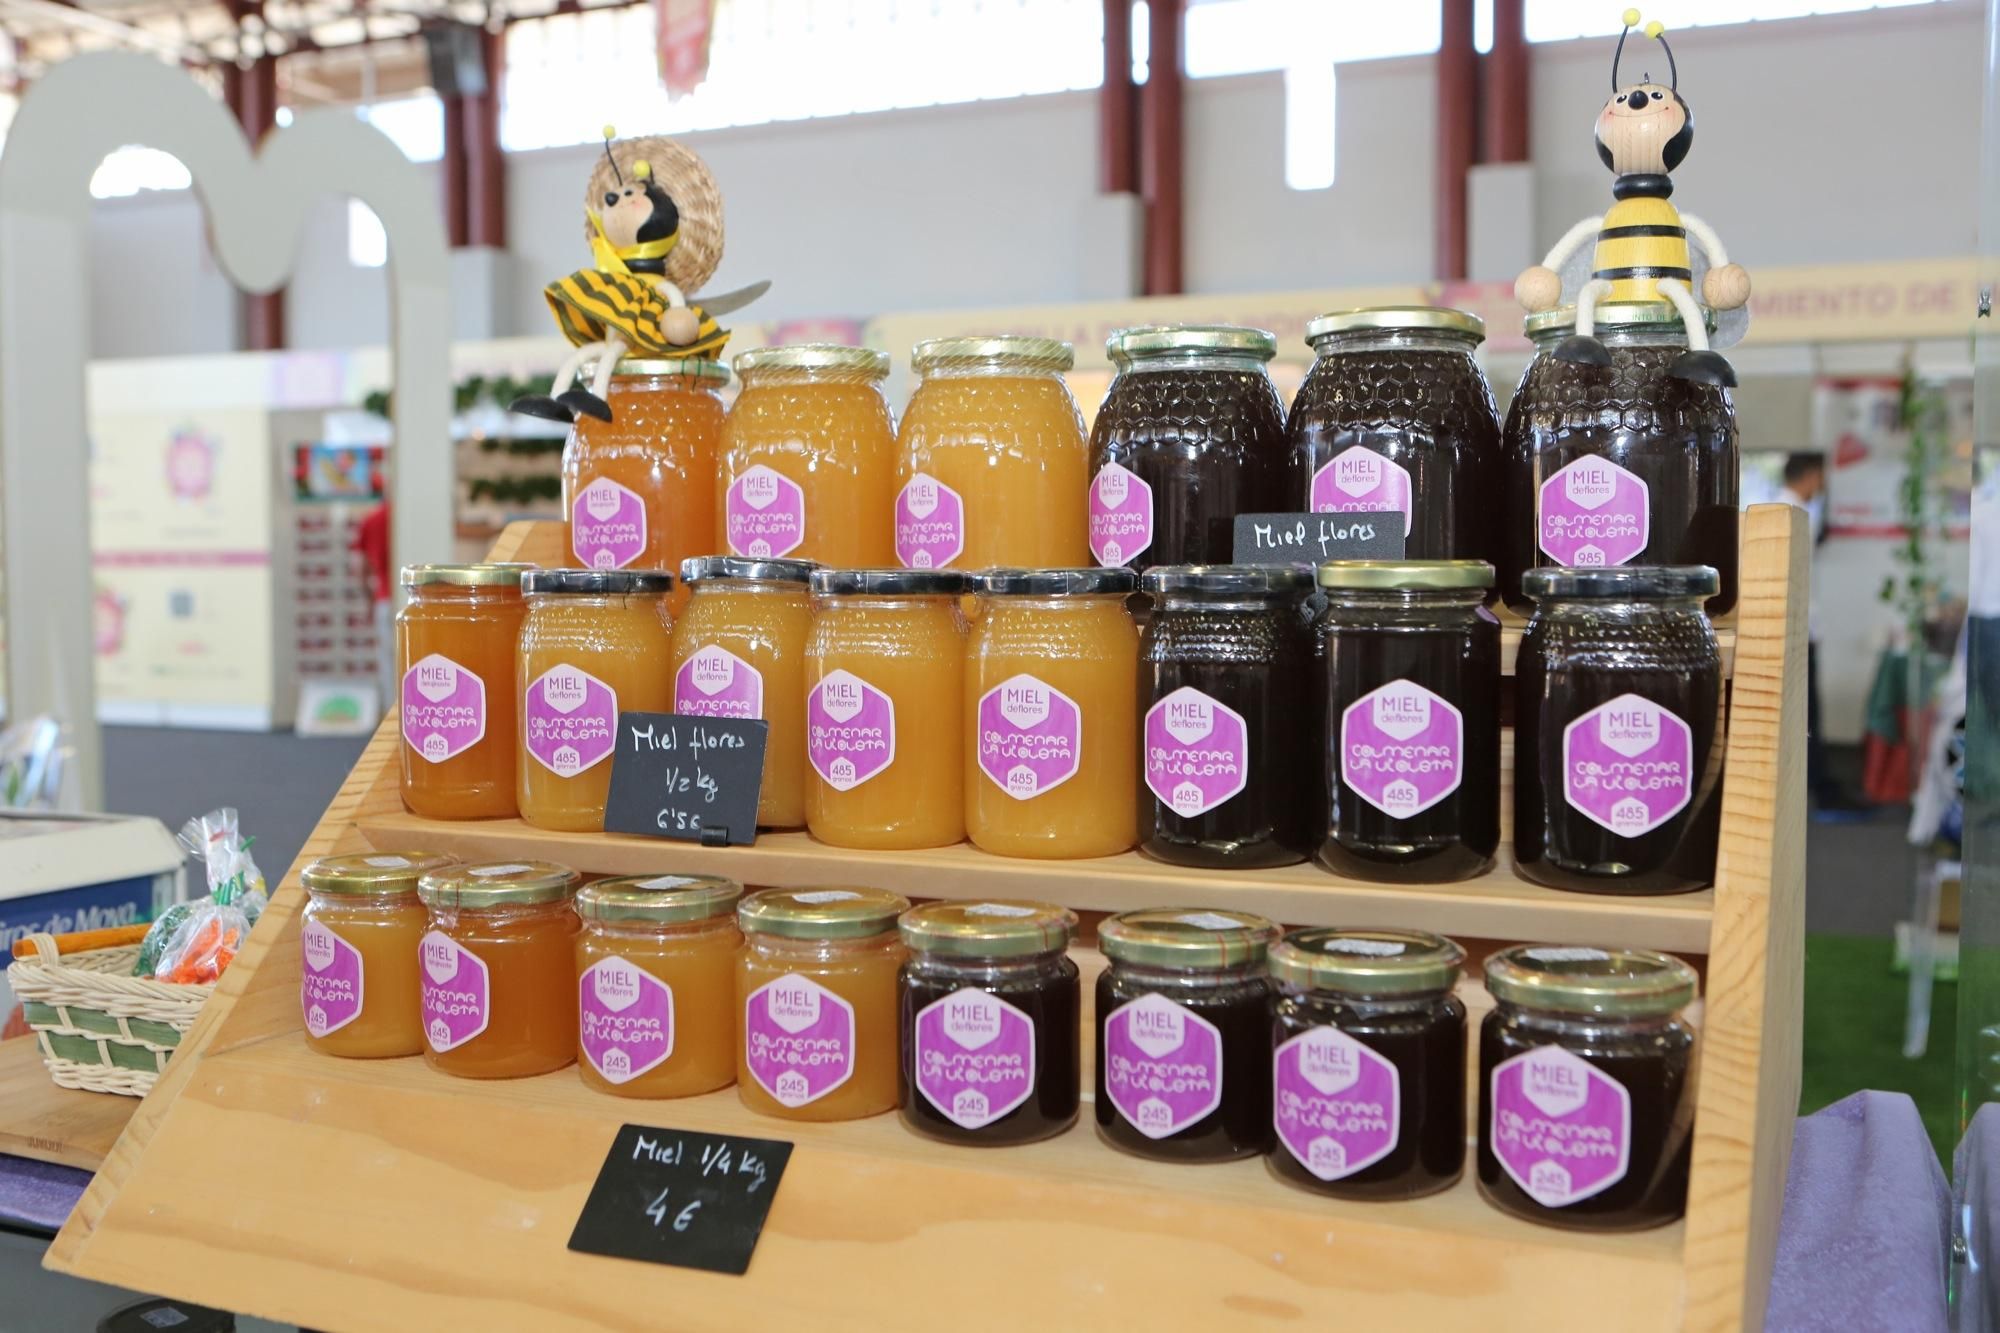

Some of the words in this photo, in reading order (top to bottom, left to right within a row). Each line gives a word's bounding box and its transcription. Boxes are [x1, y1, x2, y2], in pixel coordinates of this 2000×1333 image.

[1751, 283, 1898, 318] MIENTO
[1341, 460, 1376, 474] MIEL
[746, 476, 773, 489] MIEL
[1102, 474, 1123, 487] MIEL
[1573, 470, 1610, 484] MIEL
[591, 489, 616, 500] MIEL
[911, 484, 933, 497] MIEL
[1254, 521, 1306, 549] Miel
[1318, 520, 1376, 557] flores
[751, 545, 768, 555] 985
[1104, 548, 1119, 557] 985
[914, 556, 930, 565] 985
[1578, 552, 1602, 564] 985
[697, 658, 728, 672] MIEL
[421, 667, 451, 680] MIEL
[549, 677, 581, 690] MIEL
[827, 684, 857, 698] MIEL
[1007, 688, 1043, 704] MIEL
[1172, 703, 1206, 719] MIEL
[1382, 697, 1424, 712] MIEL
[1609, 712, 1653, 727] MIEL
[426, 741, 445, 750] 485
[631, 724, 676, 752] Miel
[689, 726, 745, 760] flores
[556, 753, 576, 763] 485
[832, 765, 852, 776] 485
[697, 767, 718, 802] kg
[1010, 773, 1033, 785] 485
[1176, 790, 1198, 801] 485
[1387, 789, 1414, 800] 485
[1616, 807, 1643, 819] 485
[306, 930, 330, 949] MIEL
[427, 943, 452, 961] MIEL
[600, 969, 633, 986] MIEL
[774, 989, 814, 1006] MIEL
[951, 1004, 994, 1022] MIEL
[1136, 1010, 1176, 1030] MIEL
[1307, 1043, 1351, 1065] MIEL
[605, 1055, 627, 1069] 245
[1531, 1064, 1580, 1087] MIEL
[780, 1078, 804, 1092] 245
[958, 1098, 984, 1111] 245
[1142, 1106, 1168, 1121] 245
[1314, 1145, 1341, 1161] 245
[633, 1135, 682, 1165] Miel
[701, 1143, 731, 1177] 1/4
[739, 1151, 766, 1193] kg
[1535, 1169, 1565, 1185] 245
